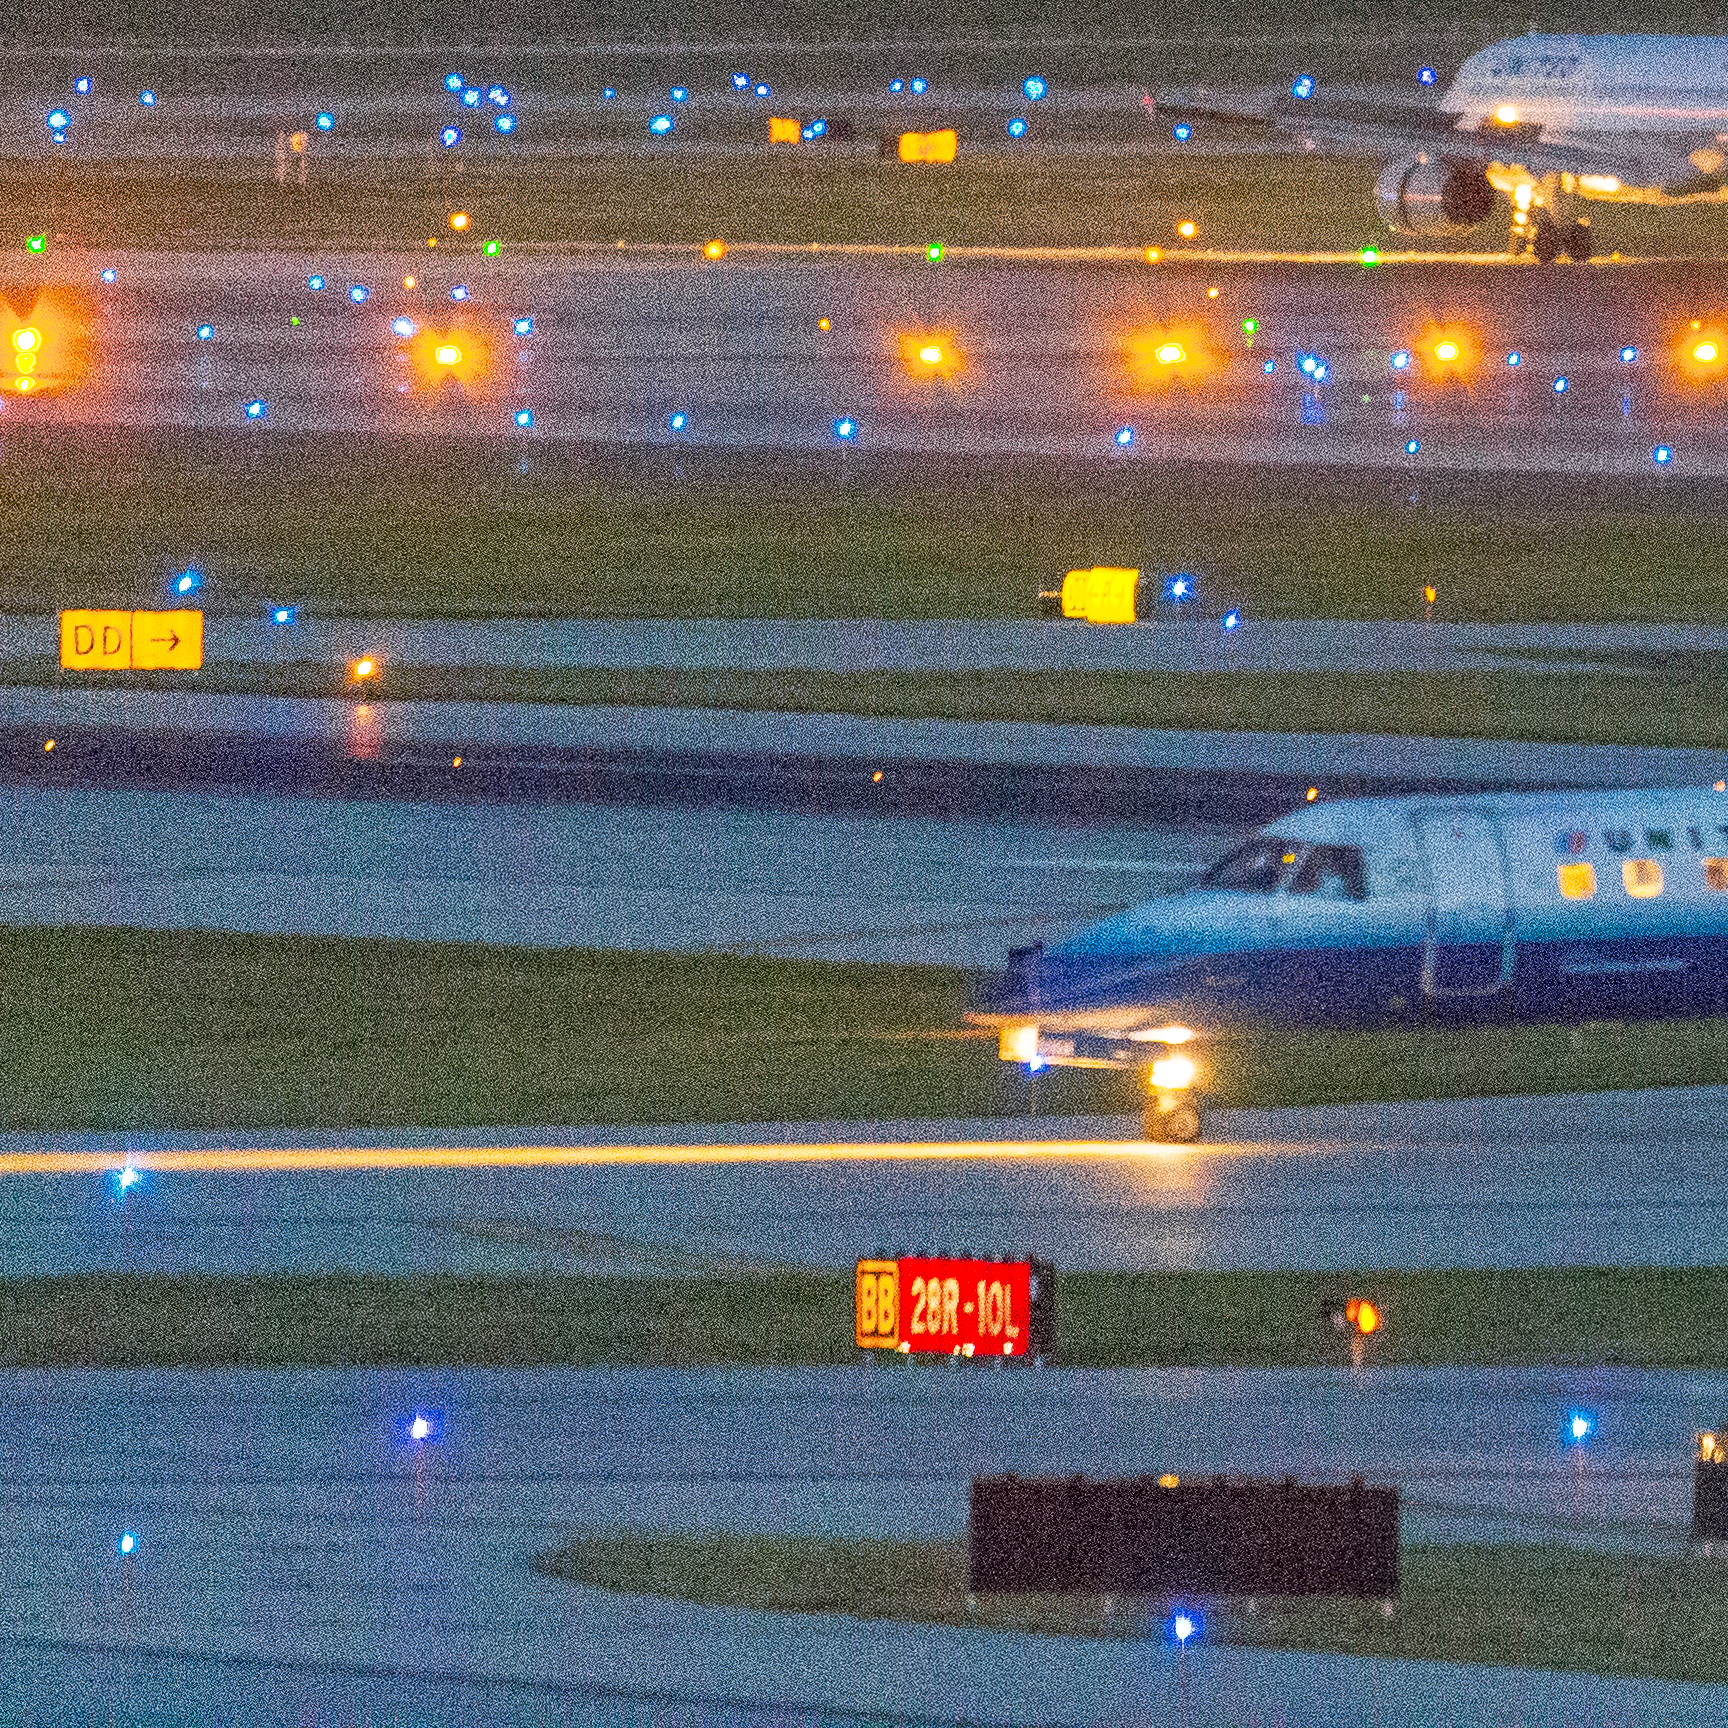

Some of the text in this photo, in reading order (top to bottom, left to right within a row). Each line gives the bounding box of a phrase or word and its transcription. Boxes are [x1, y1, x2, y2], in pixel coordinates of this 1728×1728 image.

[73, 624, 123, 657] DD
[860, 1273, 1020, 1338] BB 28R-10L
